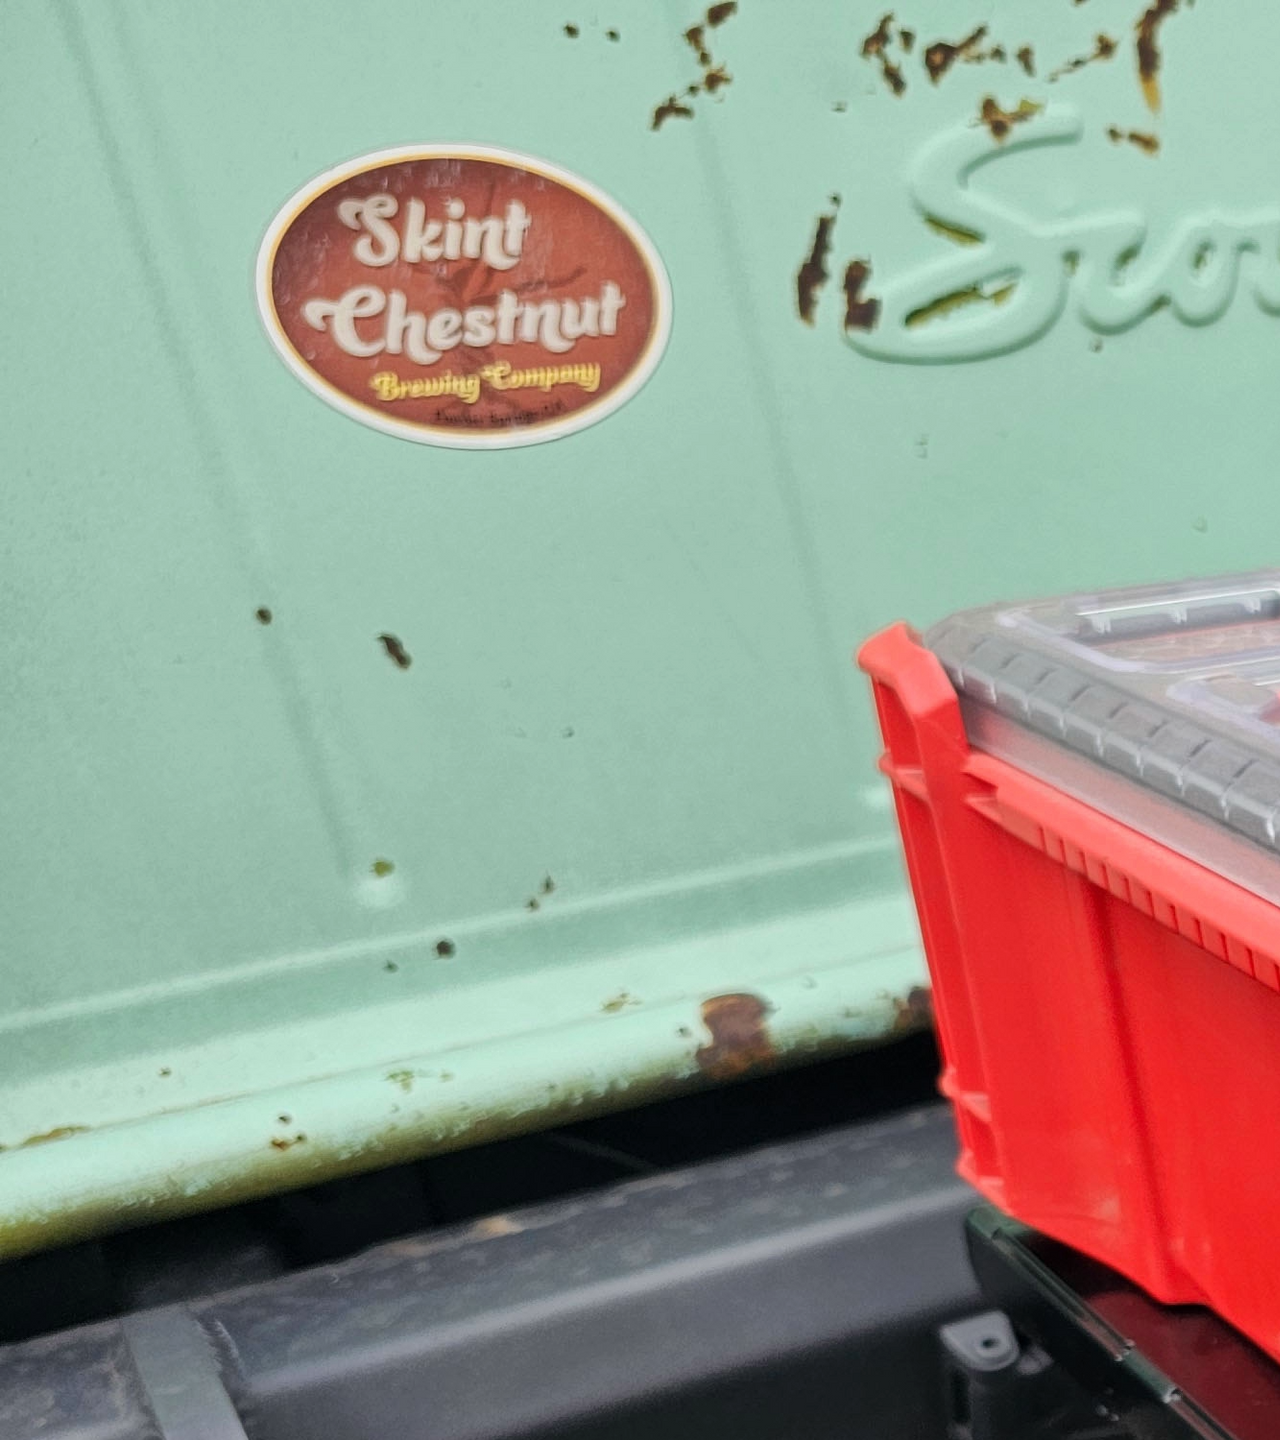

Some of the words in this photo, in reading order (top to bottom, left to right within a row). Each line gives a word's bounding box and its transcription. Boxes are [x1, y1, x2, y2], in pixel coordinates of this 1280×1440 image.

[337, 192, 532, 271] Skint
[304, 280, 627, 365] Chestnut
[370, 372, 480, 403] Brewing
[480, 361, 600, 392] Company
